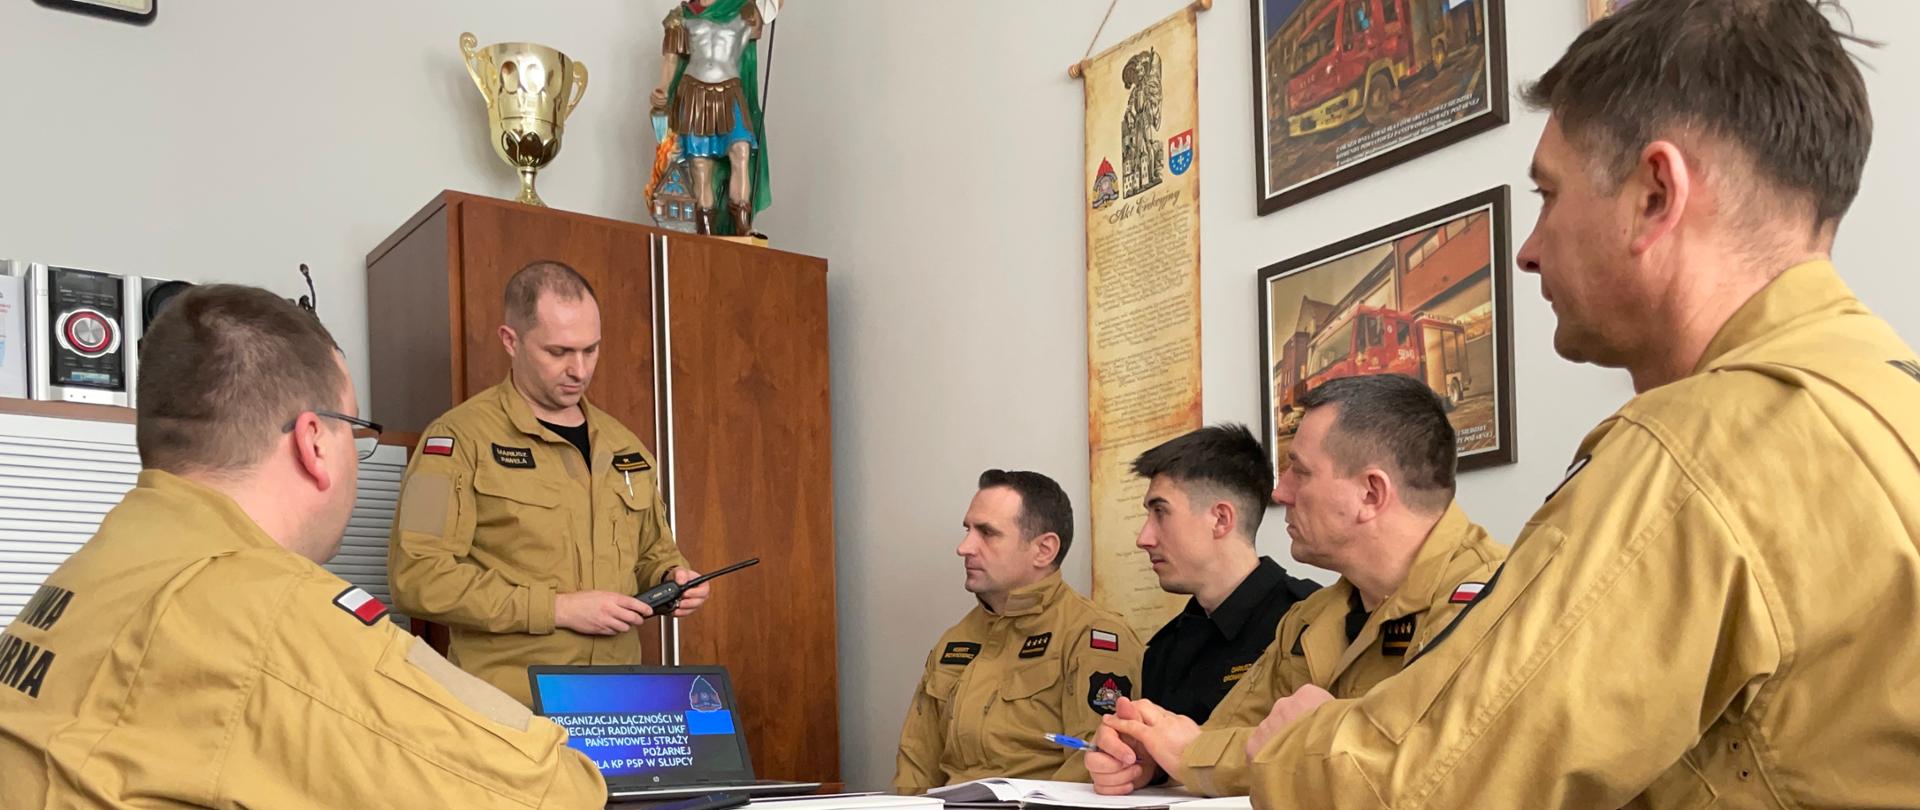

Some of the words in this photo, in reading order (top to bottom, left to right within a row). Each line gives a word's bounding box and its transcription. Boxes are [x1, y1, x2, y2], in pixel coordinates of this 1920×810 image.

[550, 715, 619, 726] ORGANIZACJA
[674, 714, 684, 723] W
[566, 726, 606, 737] IECIACH
[607, 724, 666, 736] RADIOWYCH
[667, 724, 686, 735] UKF
[584, 735, 652, 747] PAŃSTWOWEJ
[653, 733, 689, 746] STRAŻY
[642, 745, 692, 757] POŻARNEJ
[611, 759, 624, 769] KP
[626, 758, 644, 768] PSP
[645, 757, 656, 767] W
